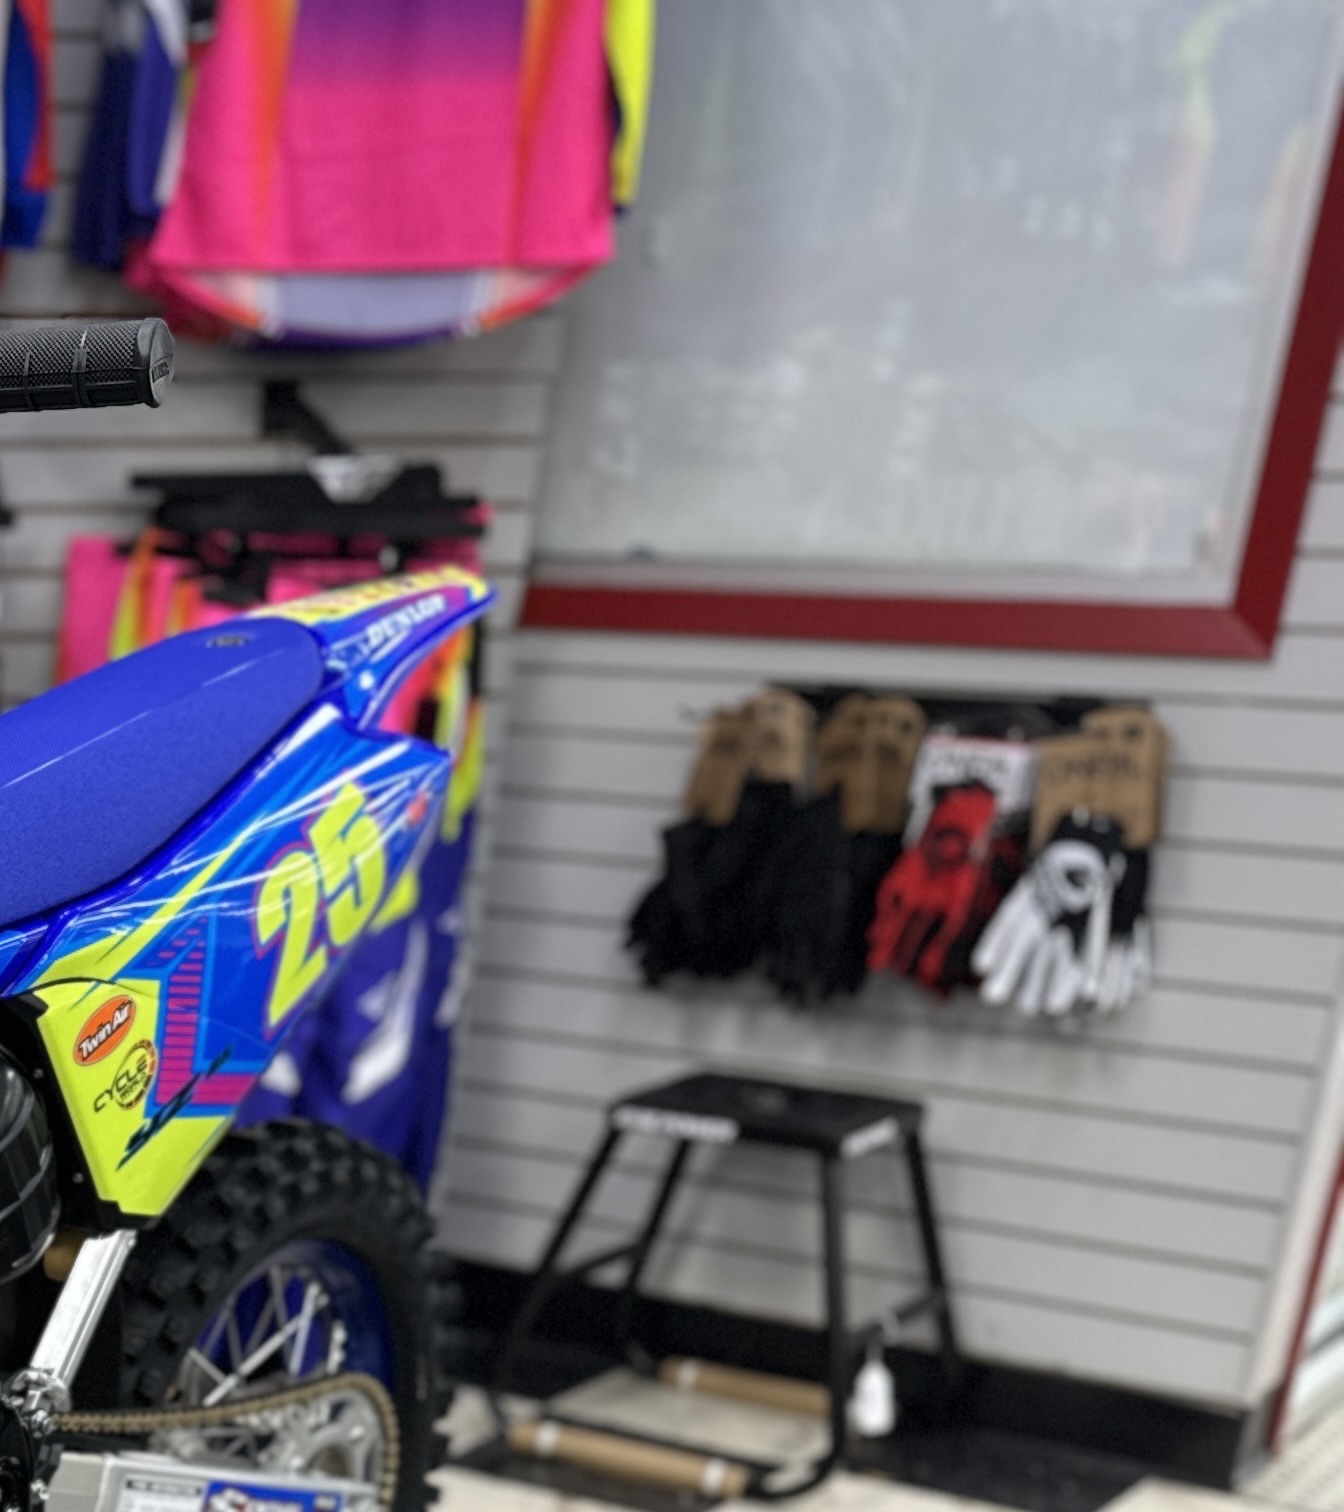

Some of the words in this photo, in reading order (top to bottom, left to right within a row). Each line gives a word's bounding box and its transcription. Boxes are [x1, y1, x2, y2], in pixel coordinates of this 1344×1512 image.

[255, 780, 386, 1029] 25
[79, 1023, 113, 1060] Twin
[112, 1000, 133, 1033] Air
[93, 1053, 149, 1113] CYCLE
